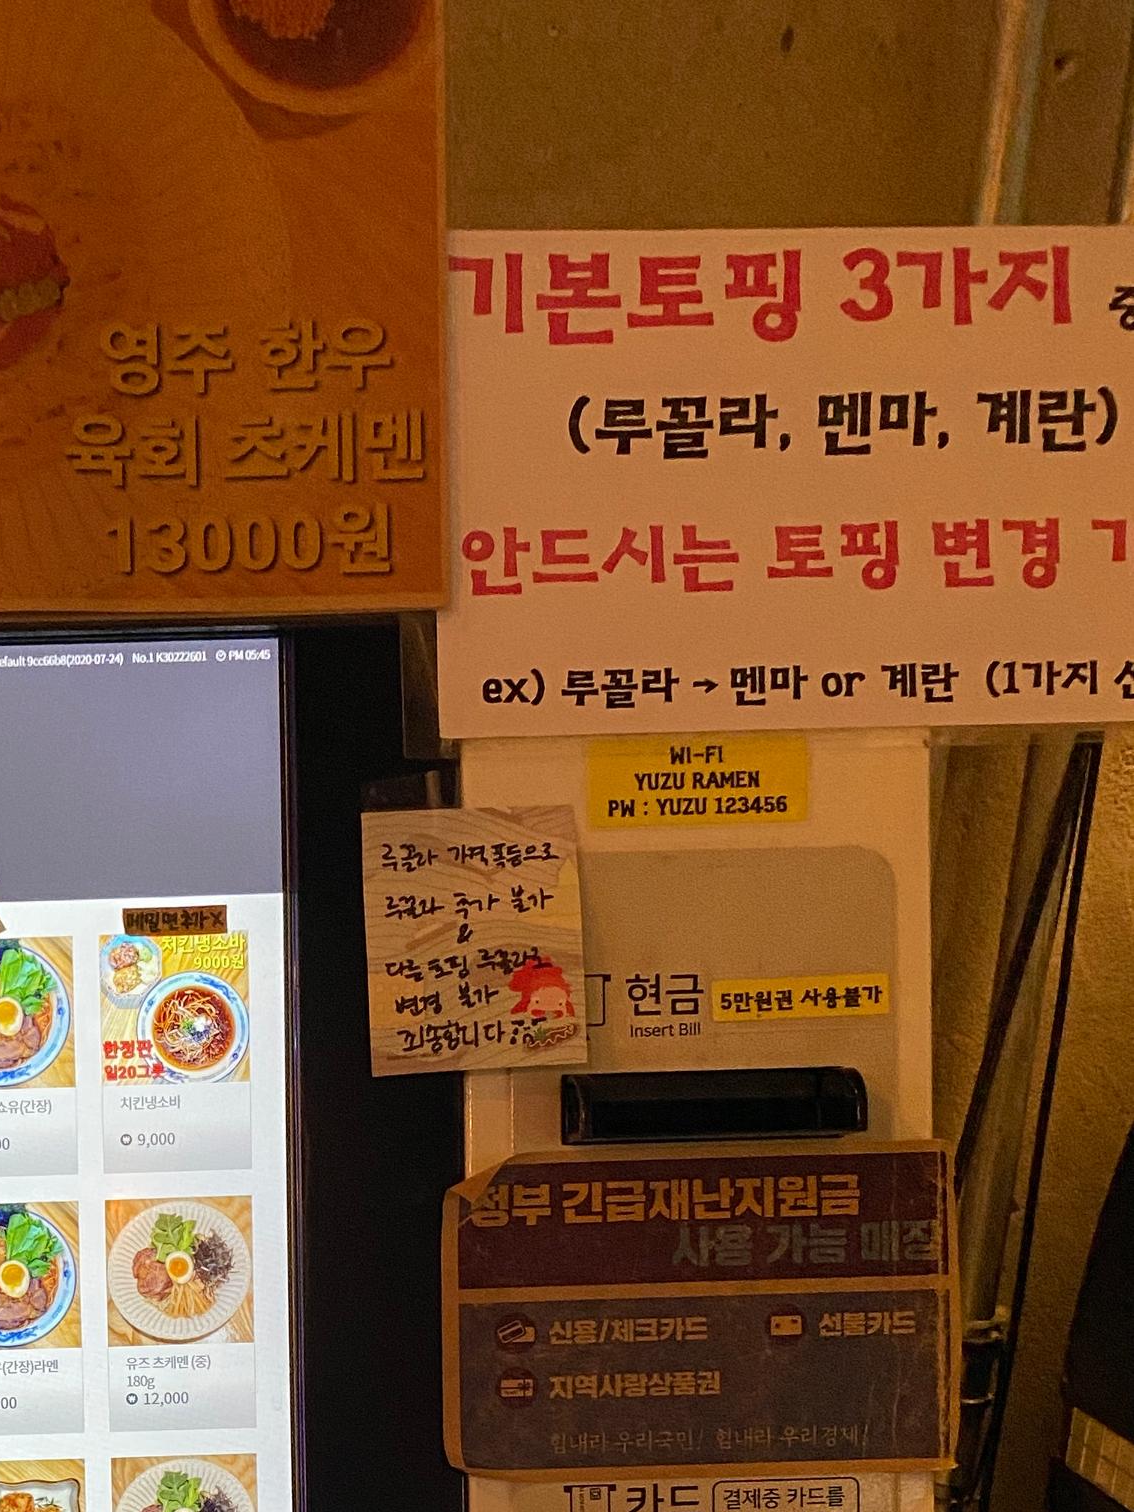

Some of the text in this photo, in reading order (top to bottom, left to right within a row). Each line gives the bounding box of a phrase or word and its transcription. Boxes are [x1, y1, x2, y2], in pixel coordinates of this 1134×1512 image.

[448, 244, 1073, 347] 기본토핑 3가지
[98, 319, 394, 398] 영주 한우
[567, 385, 1119, 459] (루꼴라, 멘마, 계란)
[66, 407, 428, 487] 육회 츠케멘
[106, 503, 394, 577] 13000원
[462, 522, 740, 597] 안드시는
[767, 518, 900, 590] 토핑
[932, 516, 1061, 588] 변경
[228, 650, 243, 662] PM
[482, 667, 546, 705] ex)
[561, 667, 680, 709] 루꼴라
[730, 663, 808, 706] 멘마
[821, 673, 866, 698] or
[881, 662, 960, 704] 계란
[985, 660, 1099, 699] (1가지
[669, 745, 723, 765] WI-FI
[634, 770, 760, 792] YUZU RAMEN
[607, 796, 788, 818] PW YUZU 123456
[381, 843, 438, 872] 루꼴라
[453, 891, 500, 920] 추가
[511, 885, 554, 913] 불가
[194, 954, 244, 970] 9000원
[385, 960, 424, 982] 다른
[428, 955, 469, 979] 토핑
[395, 982, 499, 1016] 변경 불가
[625, 973, 883, 1016] 현금 5만원권 사용불가
[397, 1019, 505, 1053] 죄송합니다
[629, 1022, 701, 1039] Insert Bill
[137, 1132, 176, 1148] 9,000
[470, 1175, 861, 1228] 정부 긴급재난지원금
[672, 1218, 941, 1268] 사용 가능 매장
[549, 1311, 917, 1346] 신용/체크카드 선불카드
[126, 1355, 188, 1370] 유즈 츠케멘
[126, 1374, 155, 1390] 180g
[549, 1370, 722, 1400] 지역사랑상품권
[142, 1391, 189, 1408] 12,000
[723, 1488, 781, 1510] 결제중
[786, 1485, 845, 1508] 카드를
